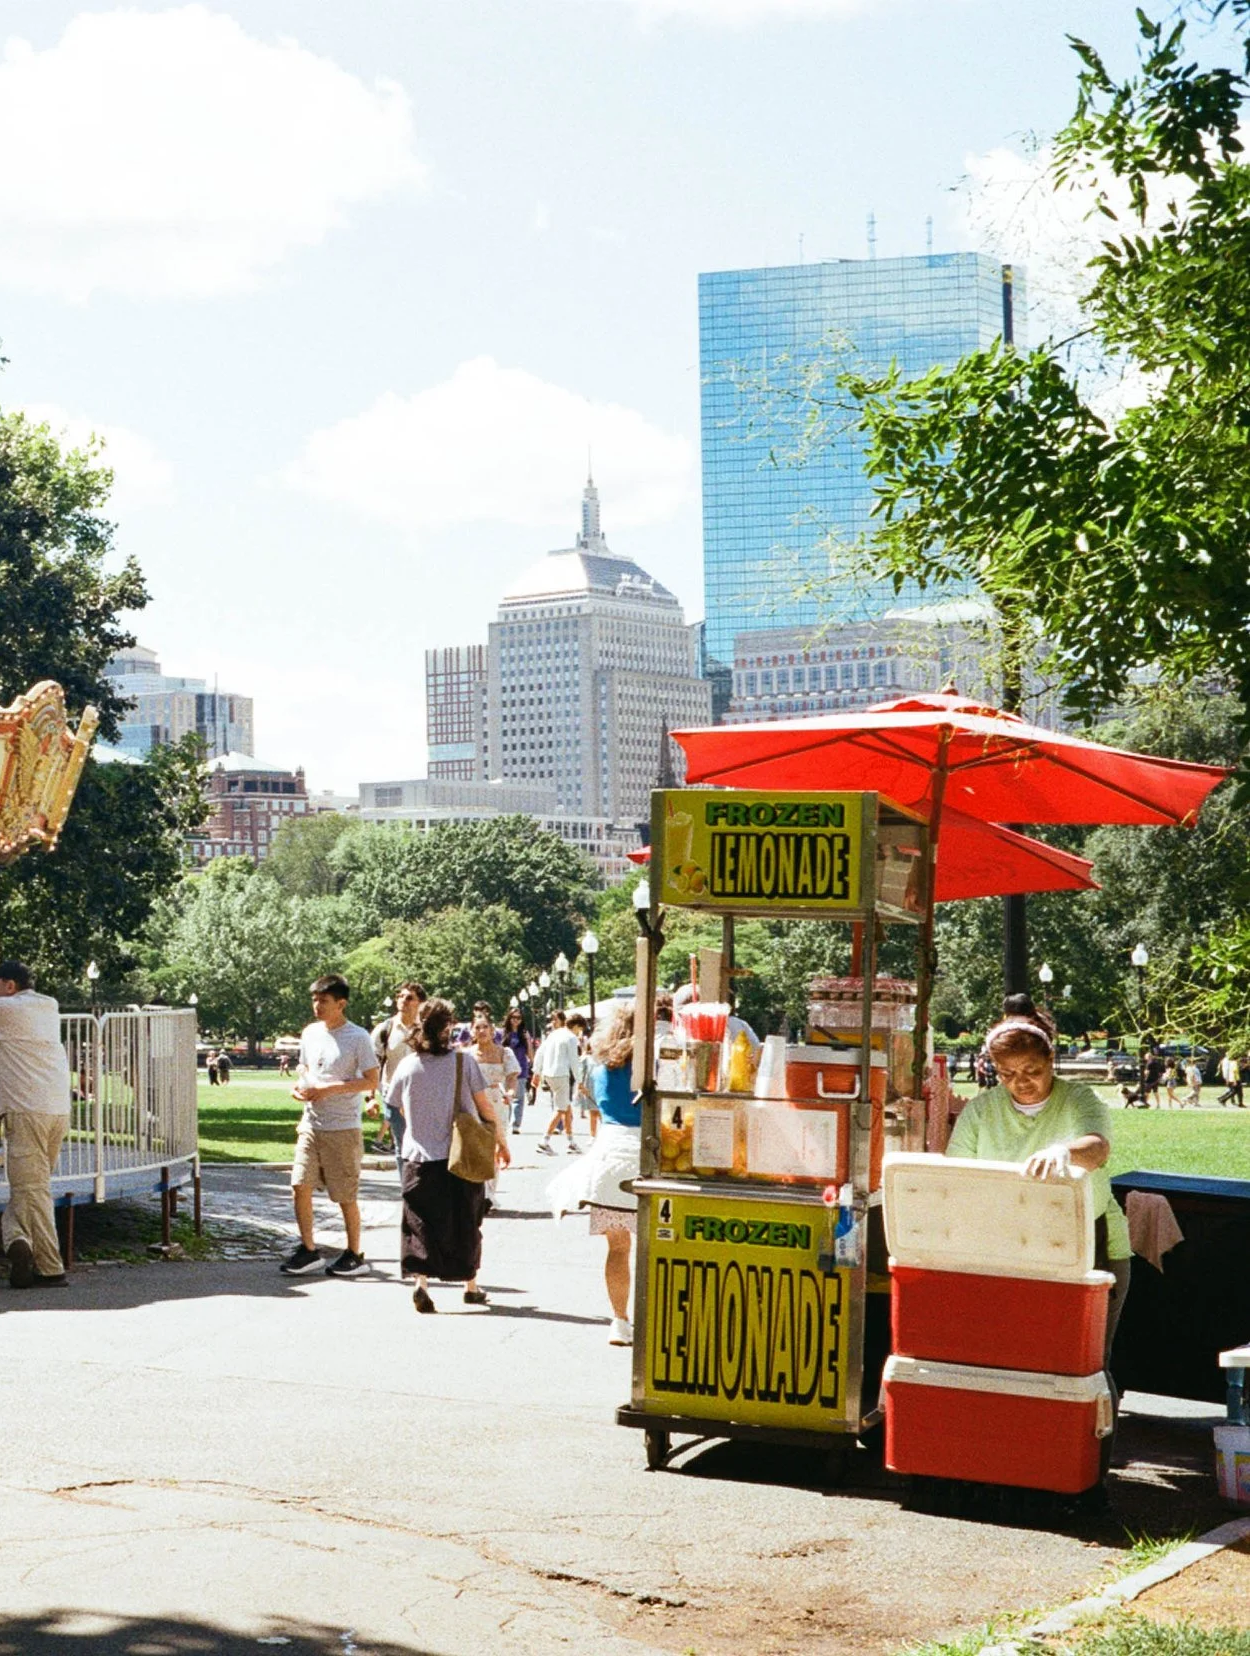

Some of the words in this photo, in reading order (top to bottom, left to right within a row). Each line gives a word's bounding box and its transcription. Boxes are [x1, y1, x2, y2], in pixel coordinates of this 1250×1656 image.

[705, 802, 844, 827] FROZEN
[710, 831, 850, 899] LEMONADE
[671, 1106, 683, 1129] 4
[660, 1199, 671, 1223] 4
[685, 1215, 811, 1250] FROZEN
[652, 1257, 842, 1409] LEMONADE
